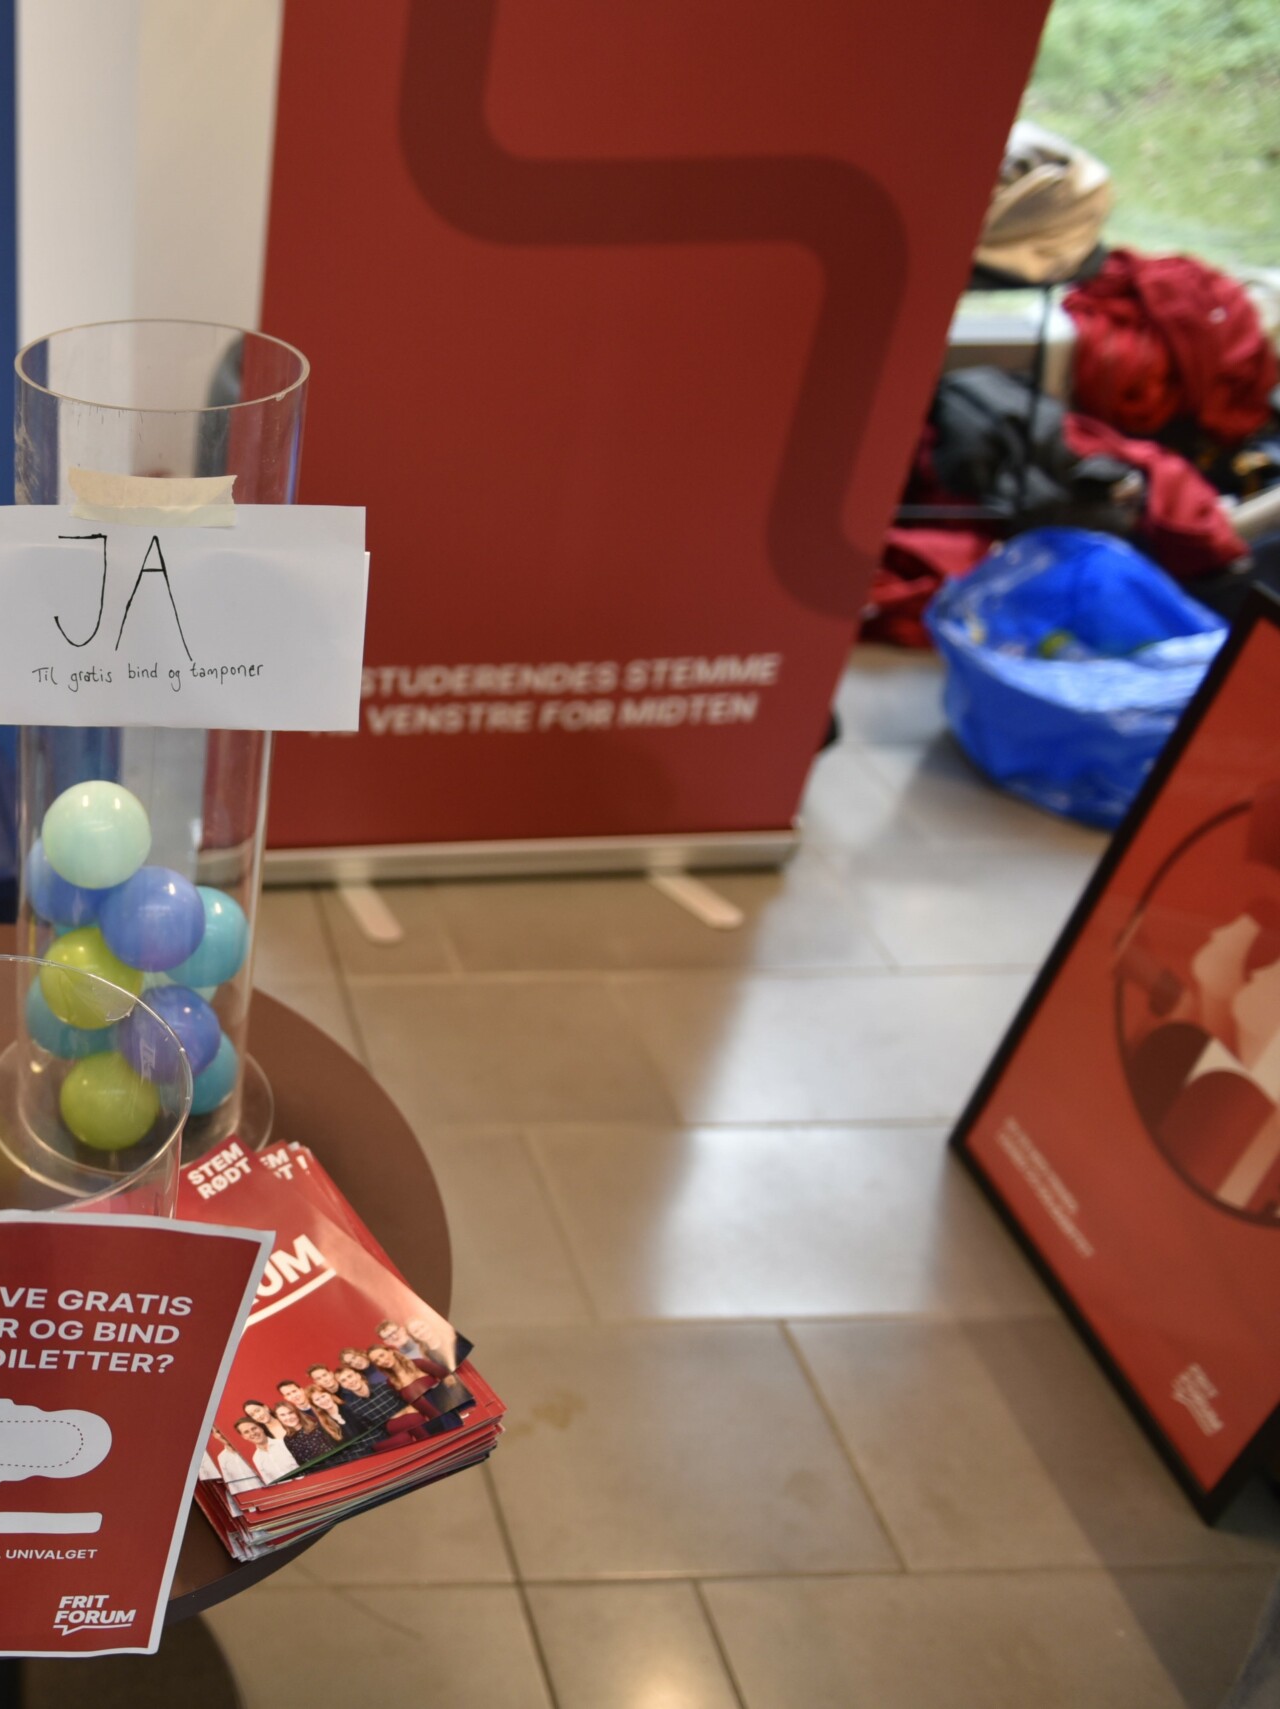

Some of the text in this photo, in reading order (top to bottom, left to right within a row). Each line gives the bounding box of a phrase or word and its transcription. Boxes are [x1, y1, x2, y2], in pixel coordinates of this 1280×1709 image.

[53, 533, 193, 662] JA
[31, 662, 265, 693] Til gratis bind og tamponer
[360, 653, 782, 697] STUDERENDES STEMME
[365, 692, 759, 736] VENSTRE FOR MIDTEN
[187, 1142, 244, 1185] STEM
[196, 1157, 252, 1200] RØDT
[57, 1289, 194, 1317] GRATIS
[28, 1318, 84, 1341] OG
[93, 1321, 180, 1344] BIND
[5, 1549, 98, 1560] UNIVALGET
[54, 1609, 137, 1624] FORUM
[58, 1594, 110, 1609] FRIT
